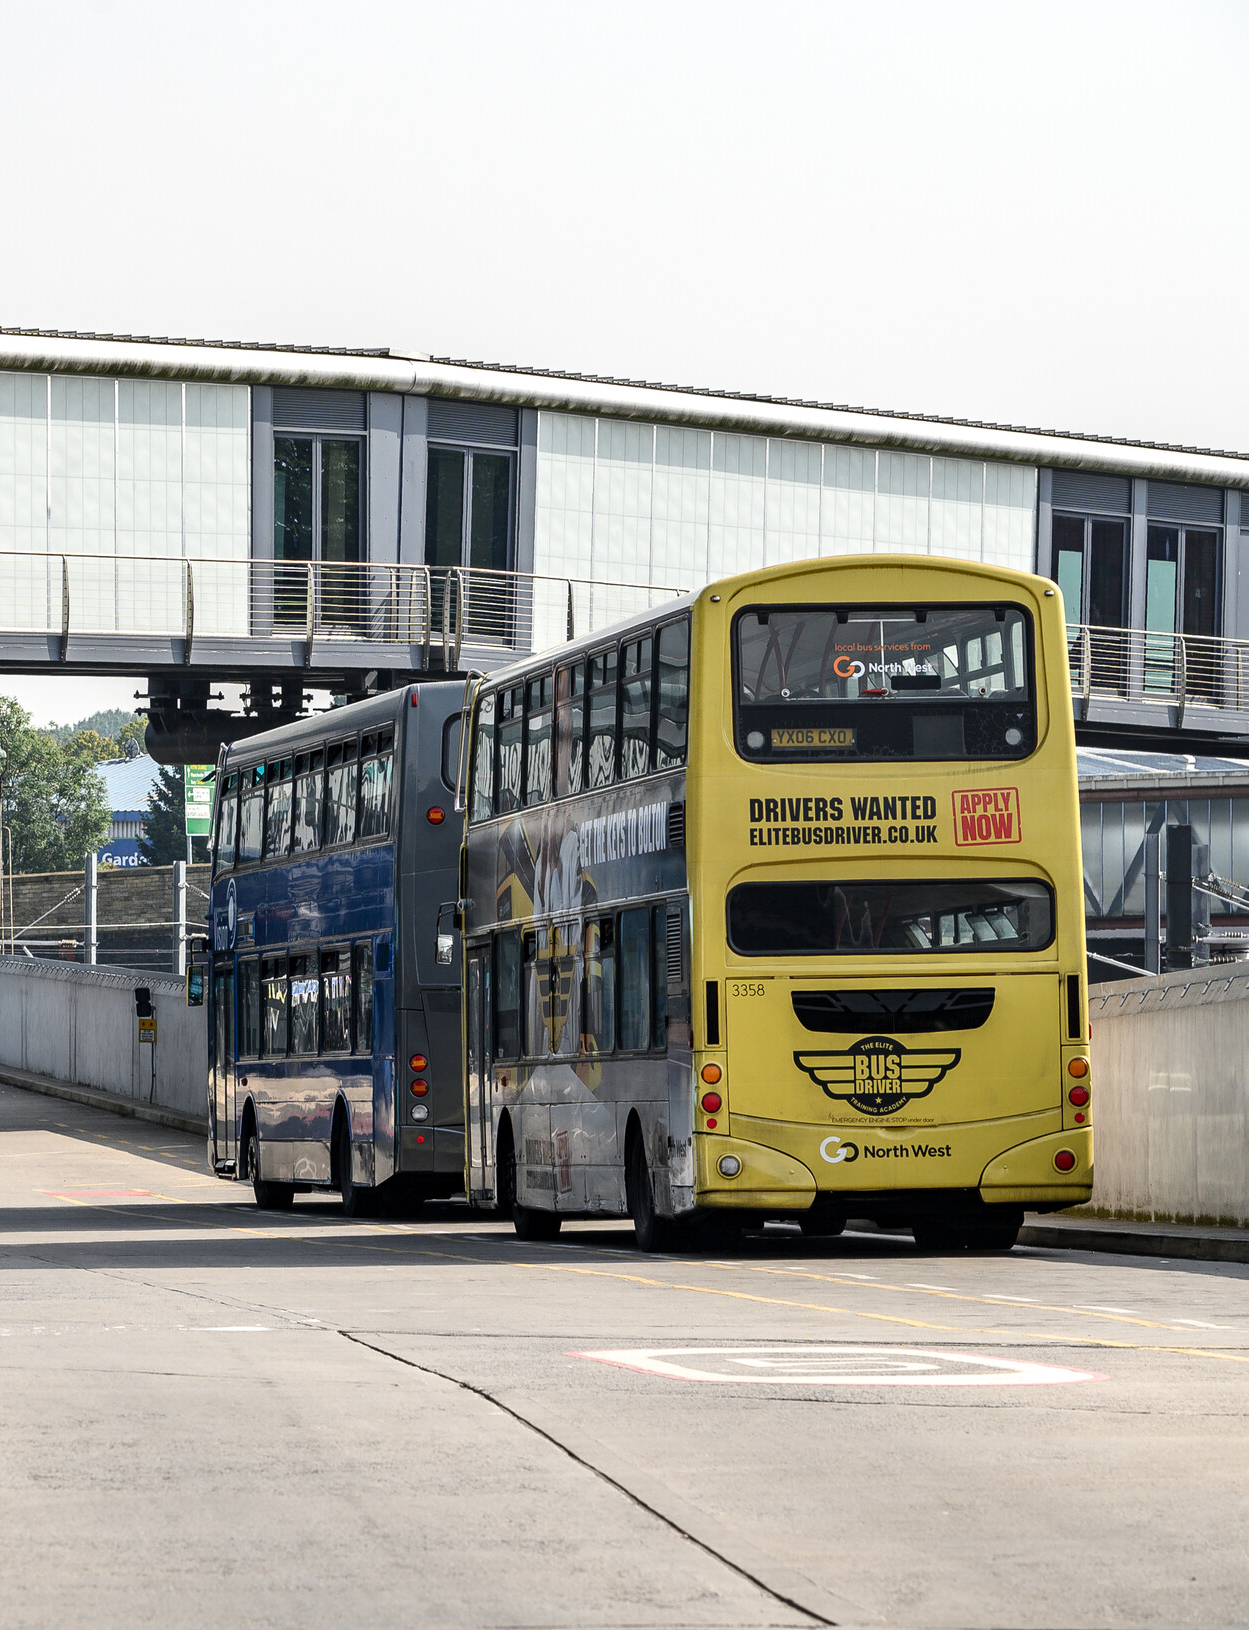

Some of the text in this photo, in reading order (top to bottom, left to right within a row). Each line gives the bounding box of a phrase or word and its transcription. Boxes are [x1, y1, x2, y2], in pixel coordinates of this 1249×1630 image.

[835, 641, 931, 652] local bus services from
[868, 662, 902, 673] North
[903, 662, 933, 673] West
[776, 729, 847, 744] YX06 CXO
[750, 795, 937, 823] DRIVERS WANTED
[960, 791, 1011, 815] APPLY
[579, 801, 667, 868] GET THE KEYS TO BOLTON
[961, 812, 1013, 842] NOW
[750, 825, 938, 847] ELITEBUSDRIVER.CO.UK
[732, 983, 765, 997] 3358
[860, 1042, 894, 1051] THE ELITE
[855, 1054, 900, 1080] BUS
[855, 1079, 901, 1094] DRIVER
[850, 1096, 907, 1113] TRAINING ACADEMY
[864, 1144, 909, 1159] North
[911, 1143, 952, 1158] West
